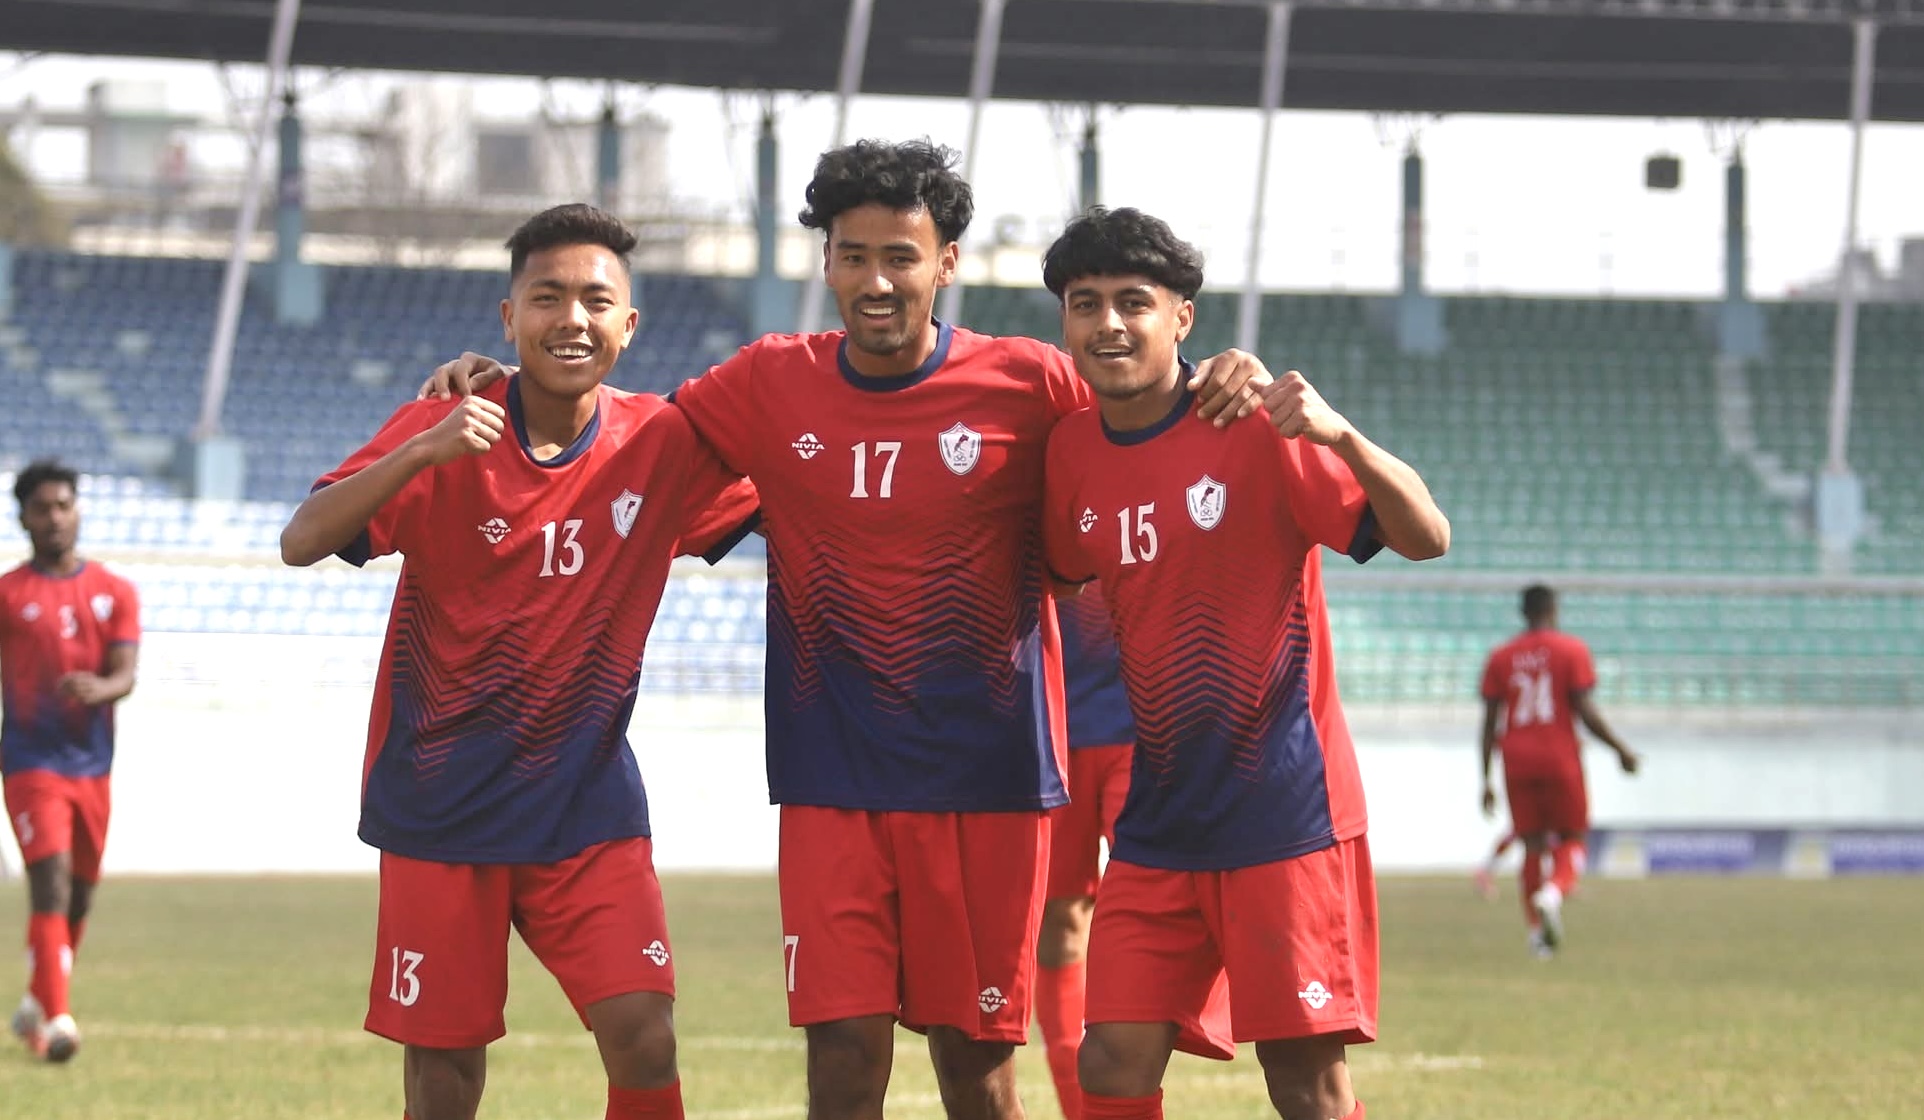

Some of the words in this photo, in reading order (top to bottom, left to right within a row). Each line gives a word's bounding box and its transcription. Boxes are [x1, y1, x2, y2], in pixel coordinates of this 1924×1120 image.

[791, 442, 825, 450] NIVIA
[849, 441, 902, 498] 17
[477, 524, 512, 535] NIVIA
[538, 519, 585, 577] 13
[1117, 501, 1158, 565] 15
[388, 946, 424, 1007] 13
[784, 935, 799, 992] 7
